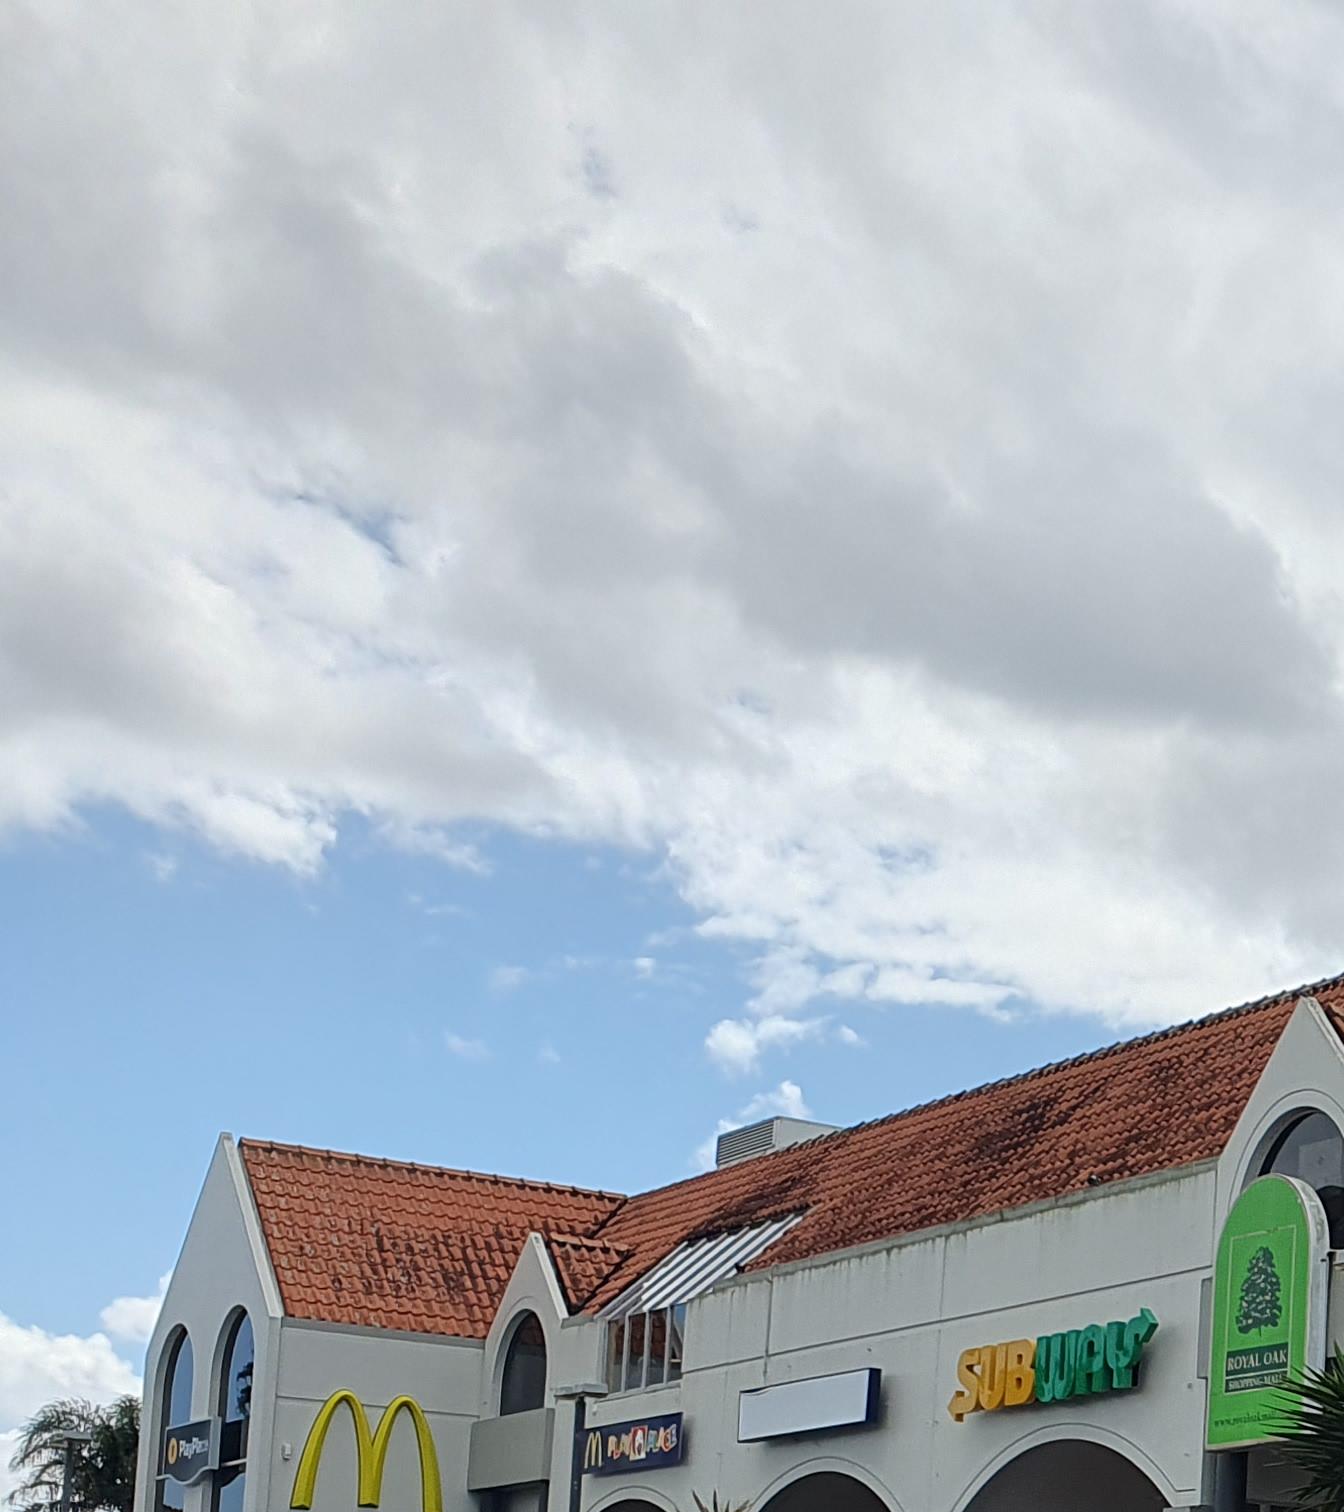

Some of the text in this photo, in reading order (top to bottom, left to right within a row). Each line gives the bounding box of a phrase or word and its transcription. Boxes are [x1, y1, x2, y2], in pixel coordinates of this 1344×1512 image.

[947, 1308, 1159, 1423] SUBWAY
[1227, 1349, 1287, 1371] ROYAL OAK
